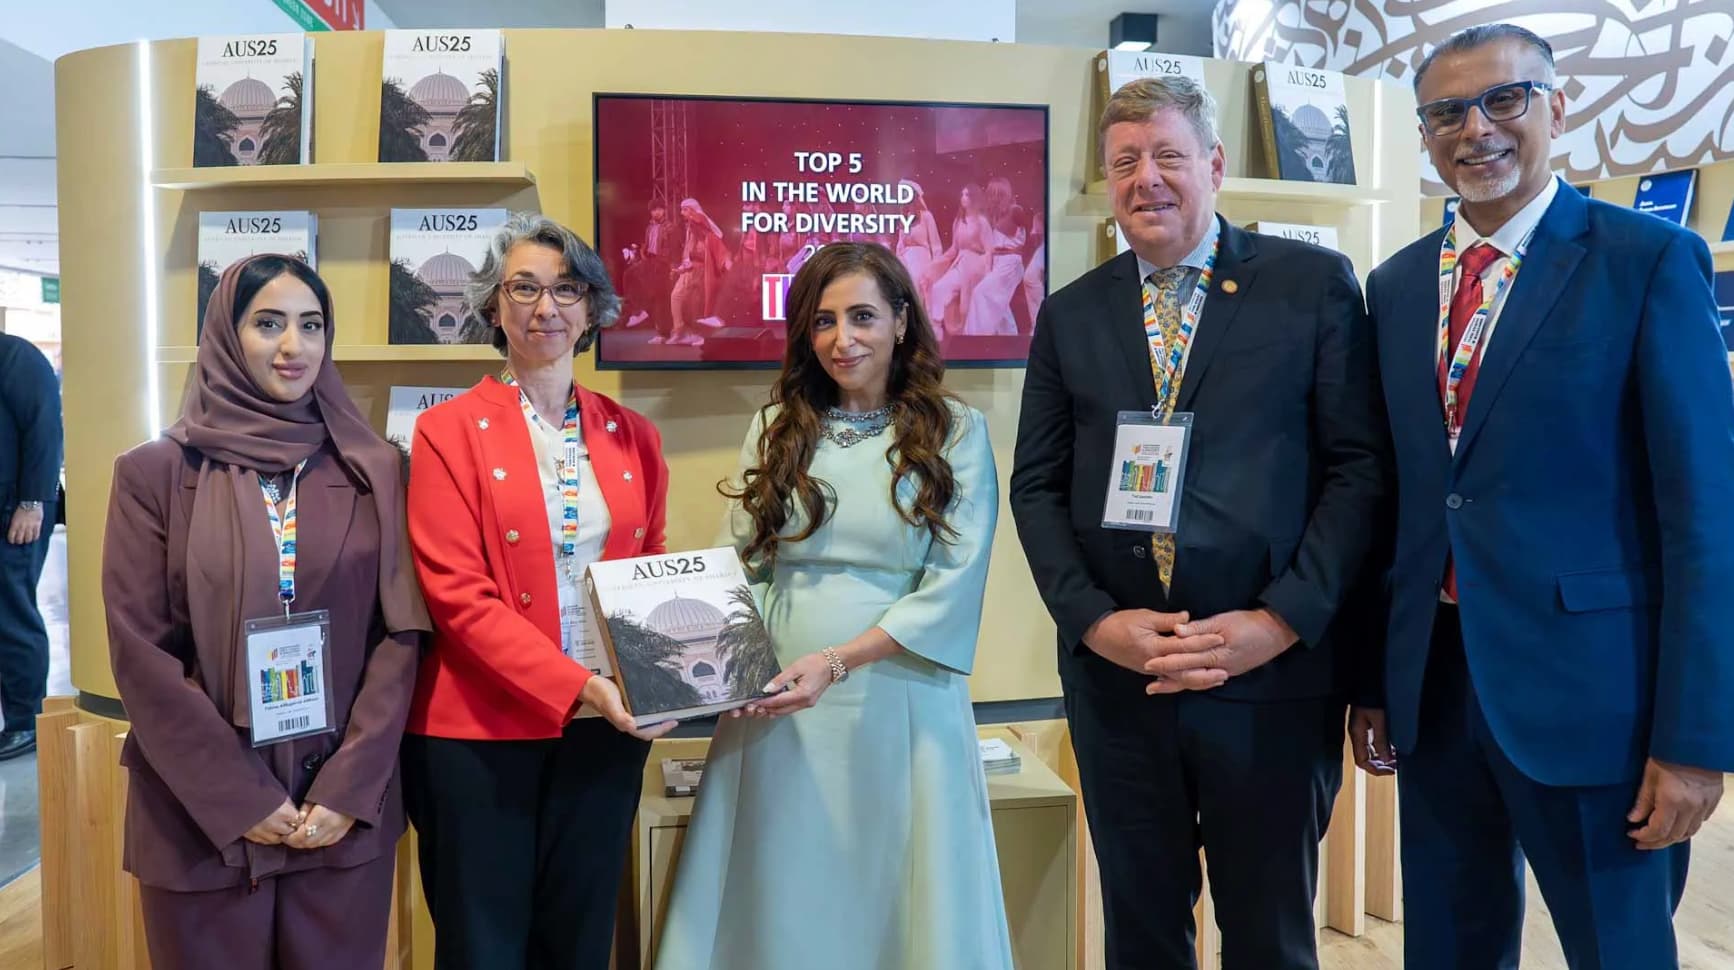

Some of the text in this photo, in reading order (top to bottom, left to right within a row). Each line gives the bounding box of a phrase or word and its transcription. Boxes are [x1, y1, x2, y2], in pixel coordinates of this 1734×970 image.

[221, 39, 278, 57] AUS25
[412, 36, 472, 52] AUS25
[1134, 56, 1182, 75] AUS25
[1287, 71, 1327, 89] AUS25
[794, 152, 863, 173] TOP 5
[742, 182, 914, 204] IN THE WORLD
[225, 217, 281, 234] AUS25
[419, 215, 478, 231] AUS25
[741, 212, 915, 234] FOR DIVERSITY
[632, 556, 706, 581] AUS25
